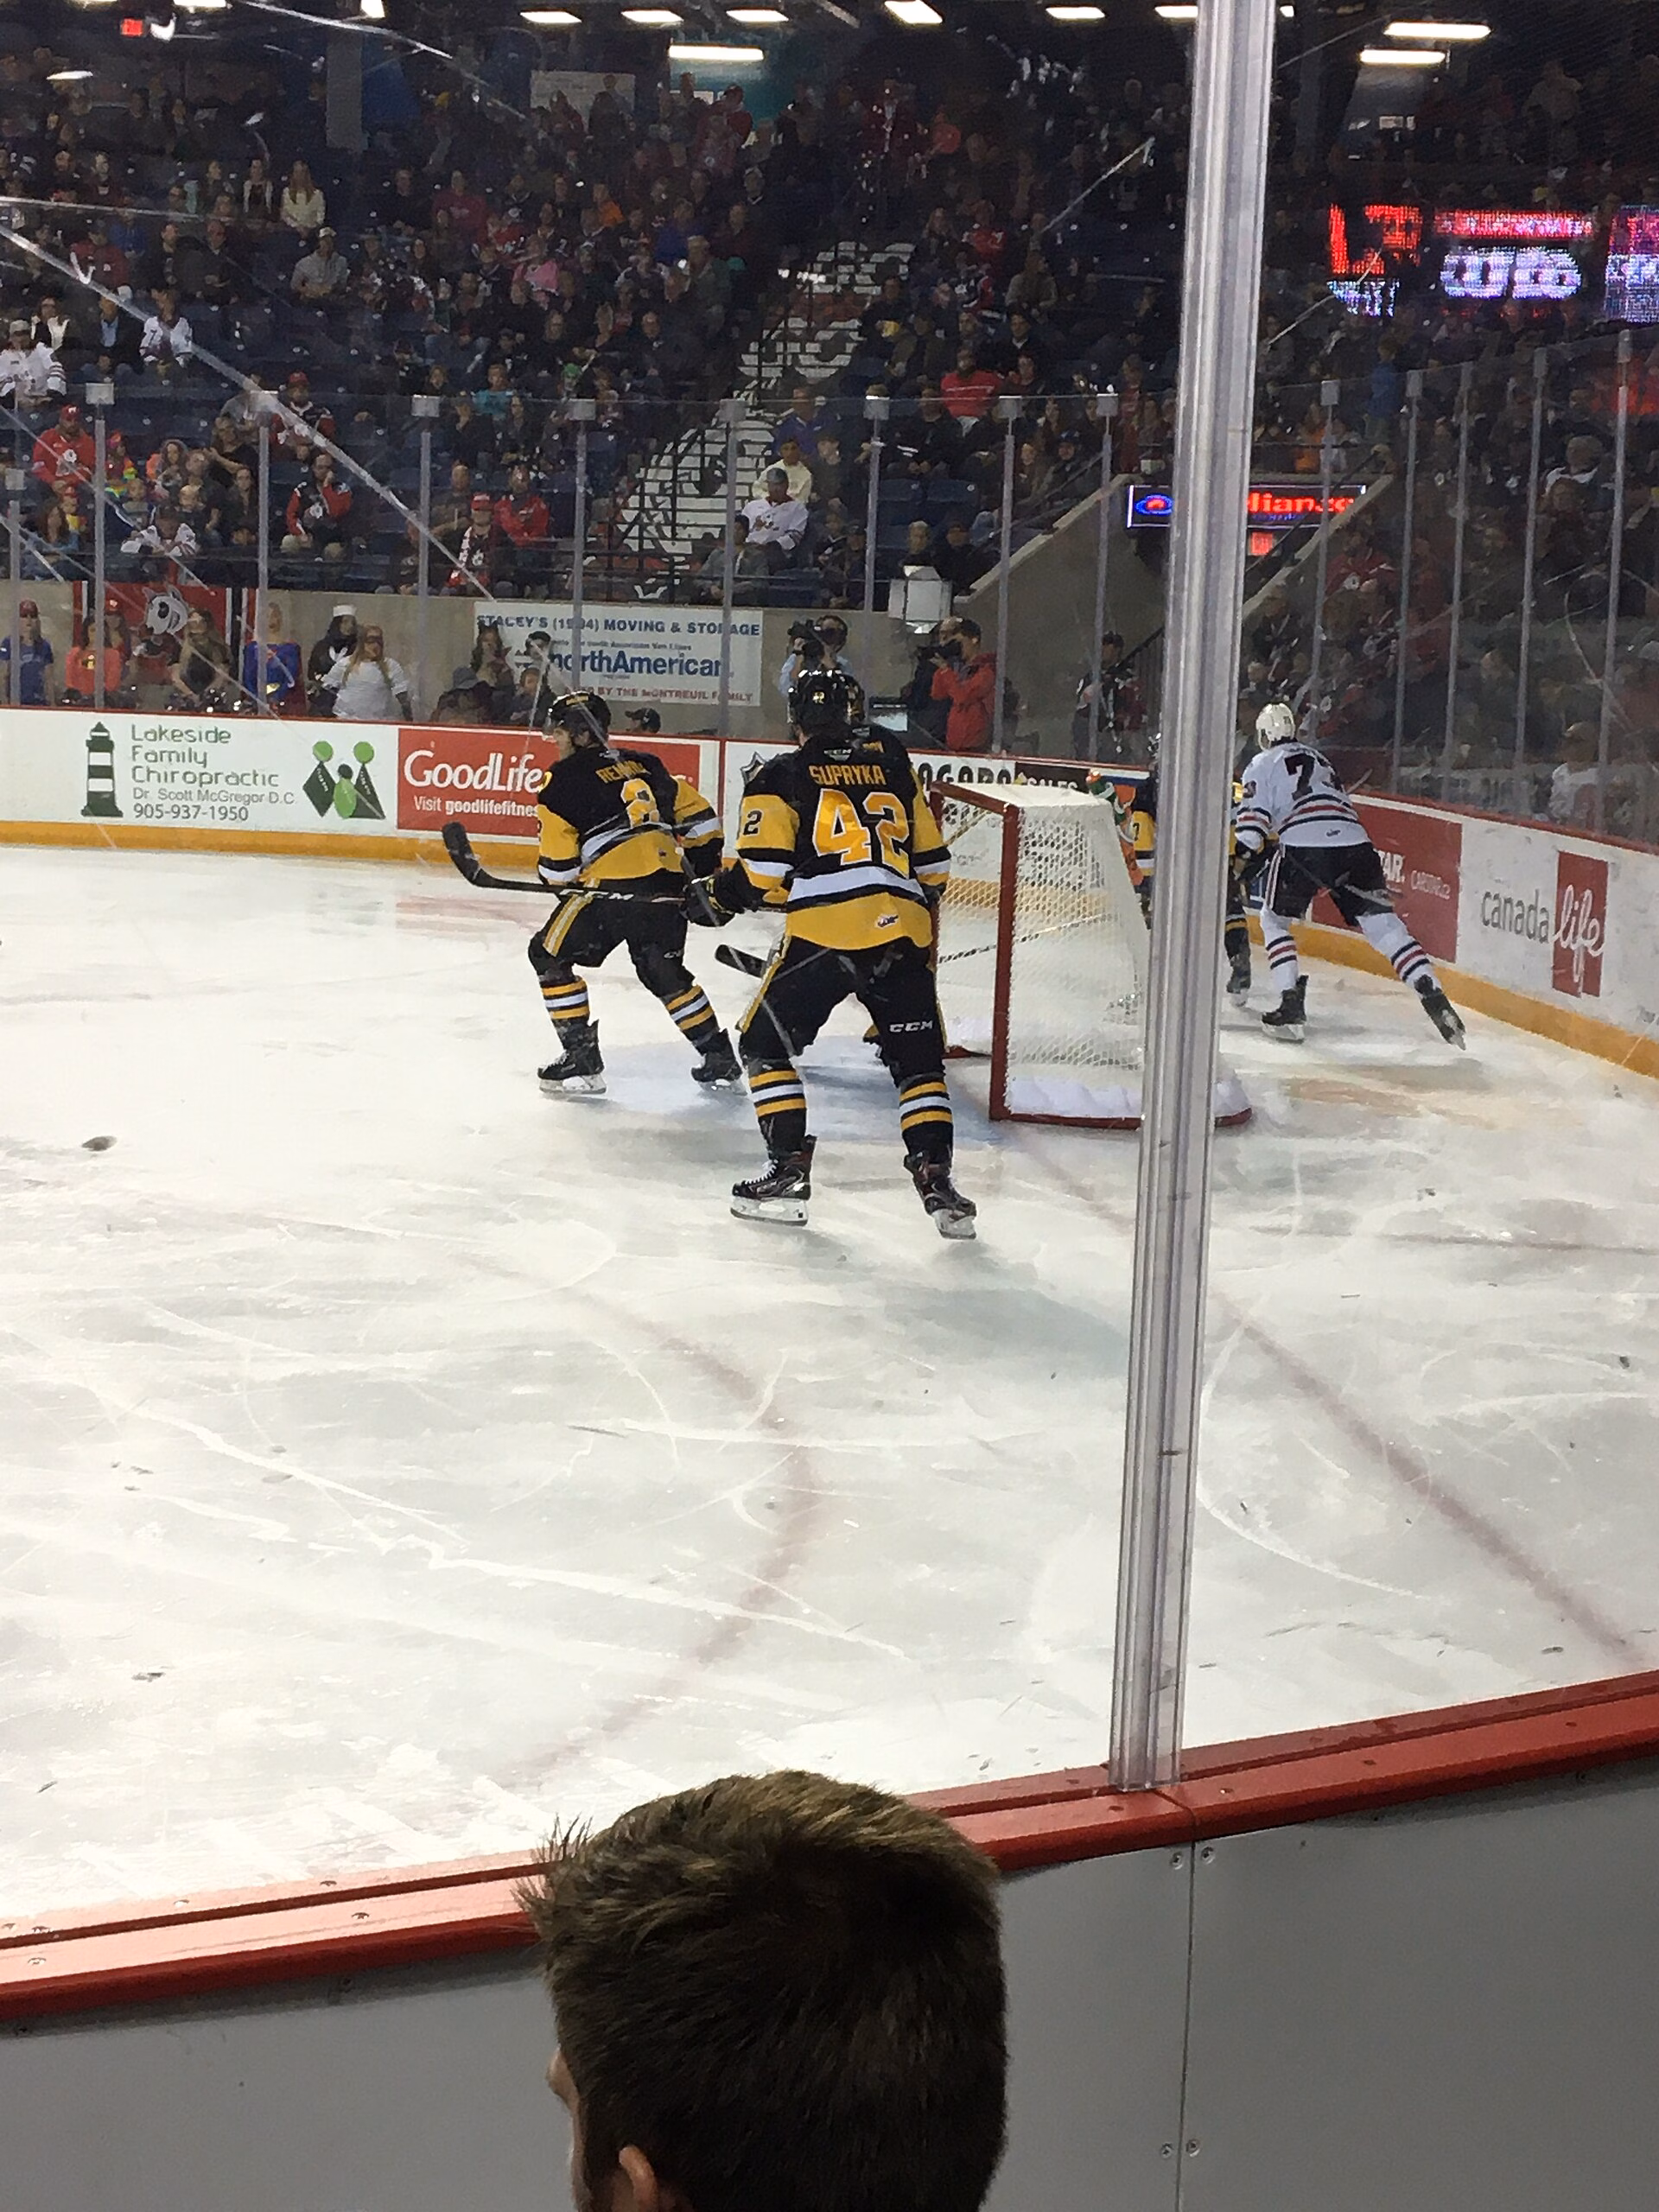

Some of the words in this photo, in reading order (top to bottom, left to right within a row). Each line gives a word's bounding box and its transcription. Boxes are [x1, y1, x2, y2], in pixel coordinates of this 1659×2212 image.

[477, 615, 548, 629] STACEY'S
[604, 619, 665, 632] MOVING
[670, 621, 683, 633] &
[616, 687, 638, 697] THE
[131, 724, 232, 744] Lakeside
[131, 745, 207, 768] Family
[131, 766, 279, 788] Chiropractic
[404, 749, 543, 793] GoodLife
[809, 765, 887, 785] SUPRYKA
[158, 788, 193, 801] Scott
[197, 790, 265, 805] McGregor
[414, 795, 442, 811] Visit
[133, 803, 249, 821] 905-937-1950
[812, 788, 910, 880] 42
[1481, 888, 1550, 944] canada
[1552, 885, 1605, 997] life
[889, 1020, 933, 1033] CCM
